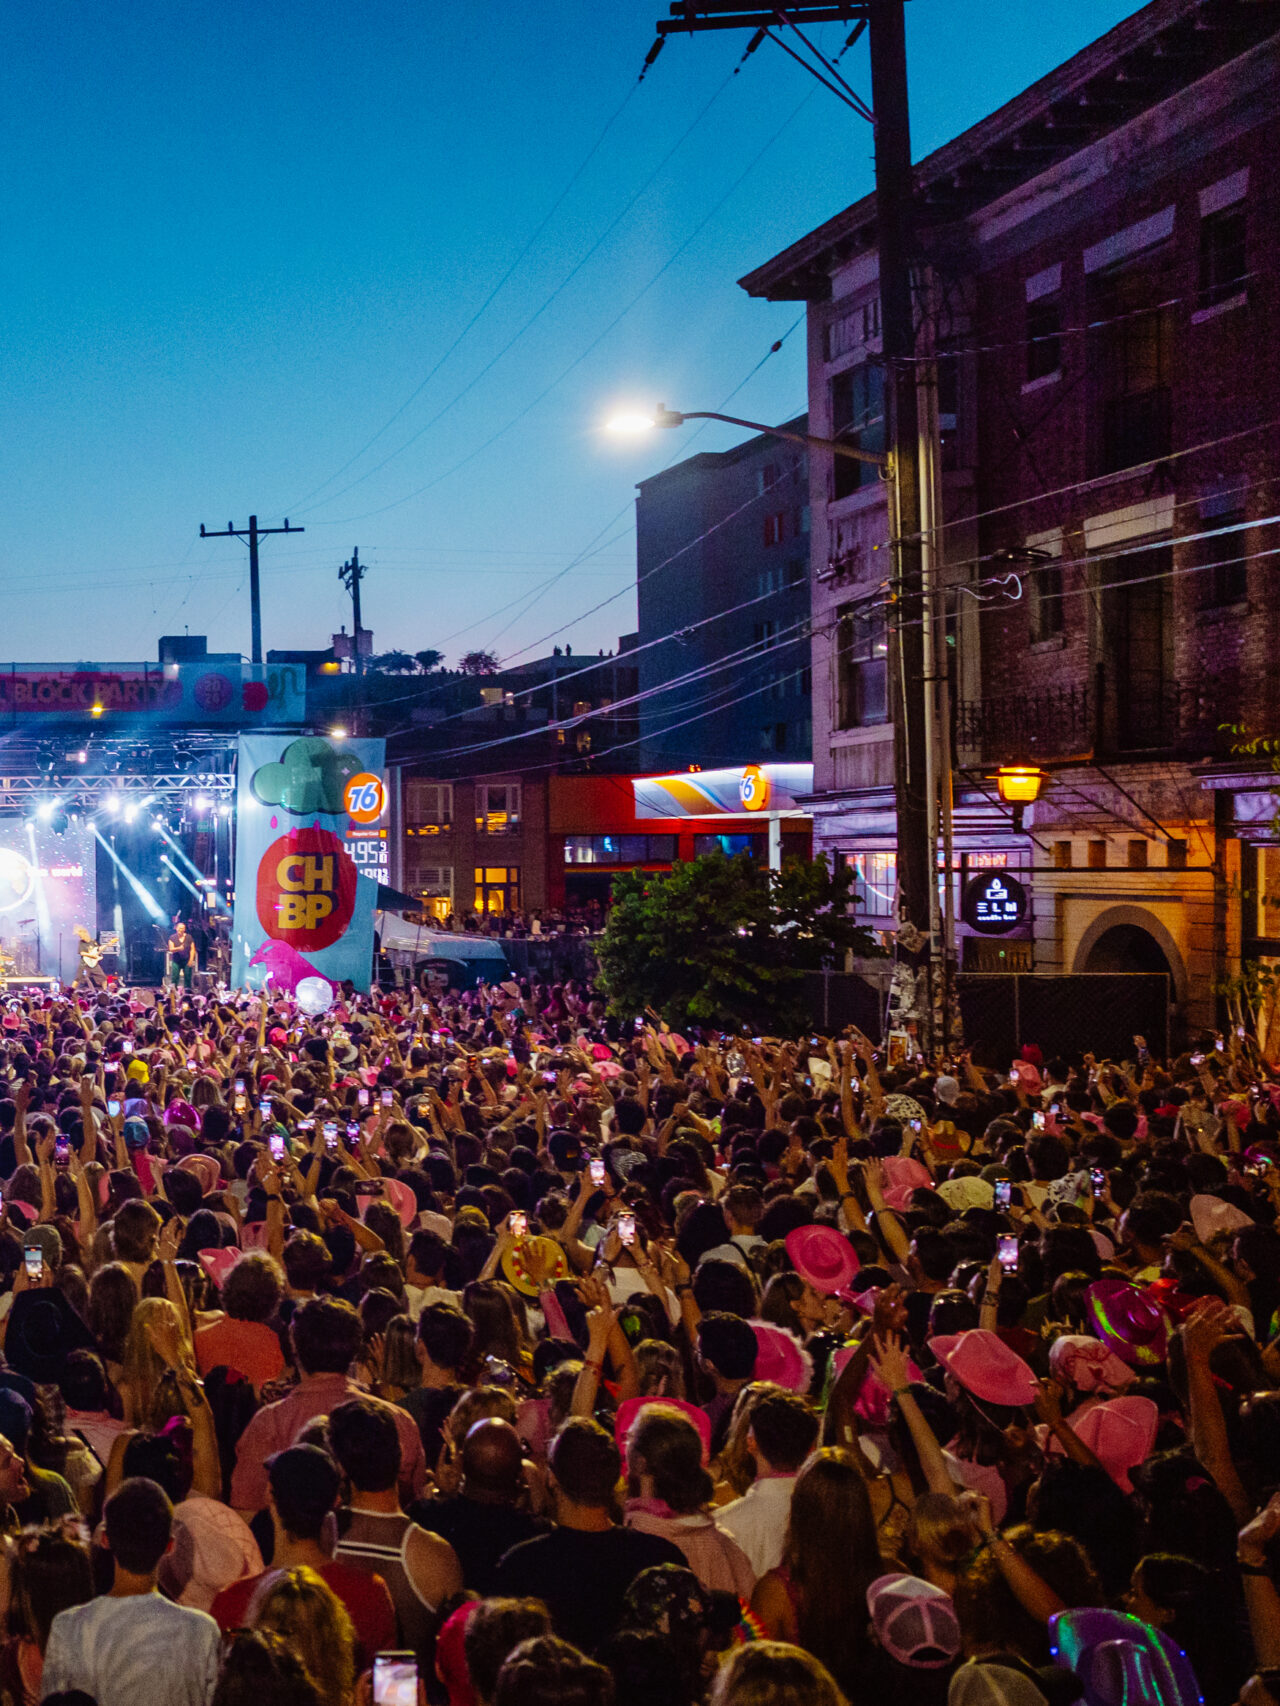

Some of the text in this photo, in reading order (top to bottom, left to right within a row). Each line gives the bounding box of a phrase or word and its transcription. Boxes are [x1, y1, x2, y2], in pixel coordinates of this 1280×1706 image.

[14, 681, 88, 704] BLOCK
[93, 680, 170, 703] PARTY
[347, 782, 379, 812] 76
[276, 855, 334, 892] CH
[277, 893, 333, 929] BP
